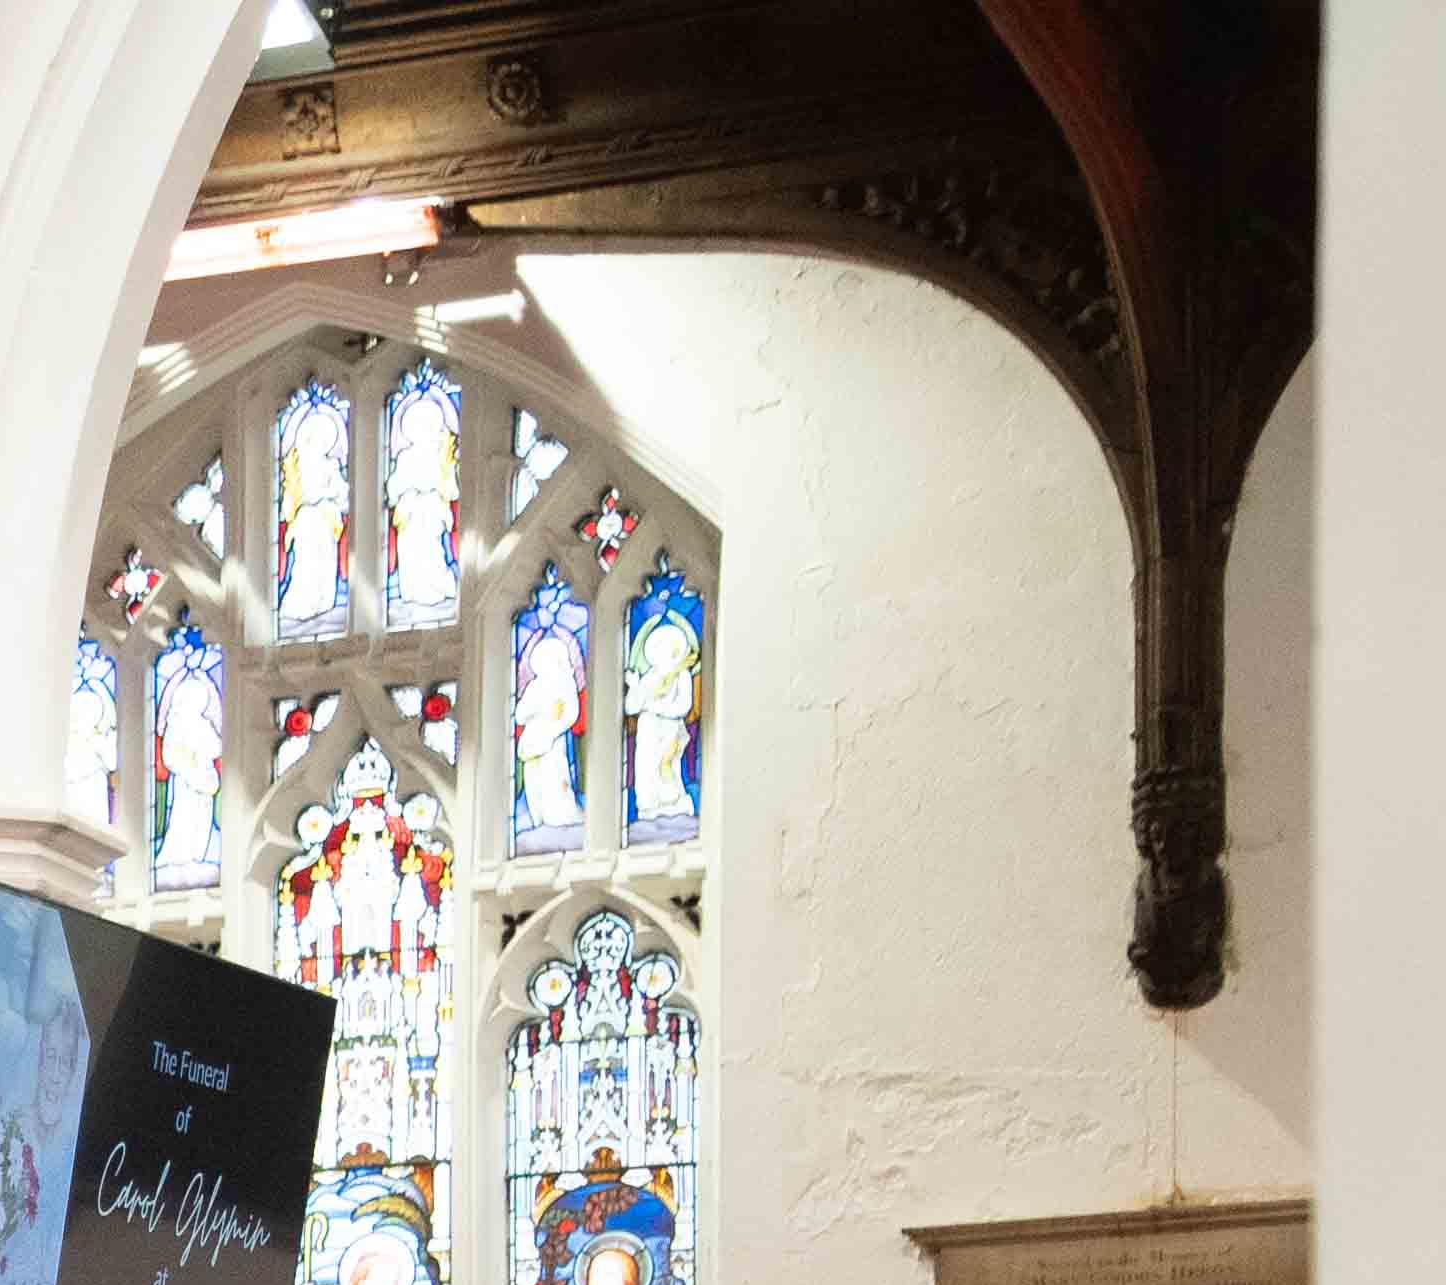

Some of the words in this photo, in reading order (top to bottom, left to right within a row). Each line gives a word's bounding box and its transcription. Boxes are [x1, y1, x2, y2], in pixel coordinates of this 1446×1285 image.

[152, 1040, 177, 1076] The
[179, 1050, 230, 1092] Funeral
[175, 1105, 193, 1134] of
[98, 1142, 171, 1232] Carol
